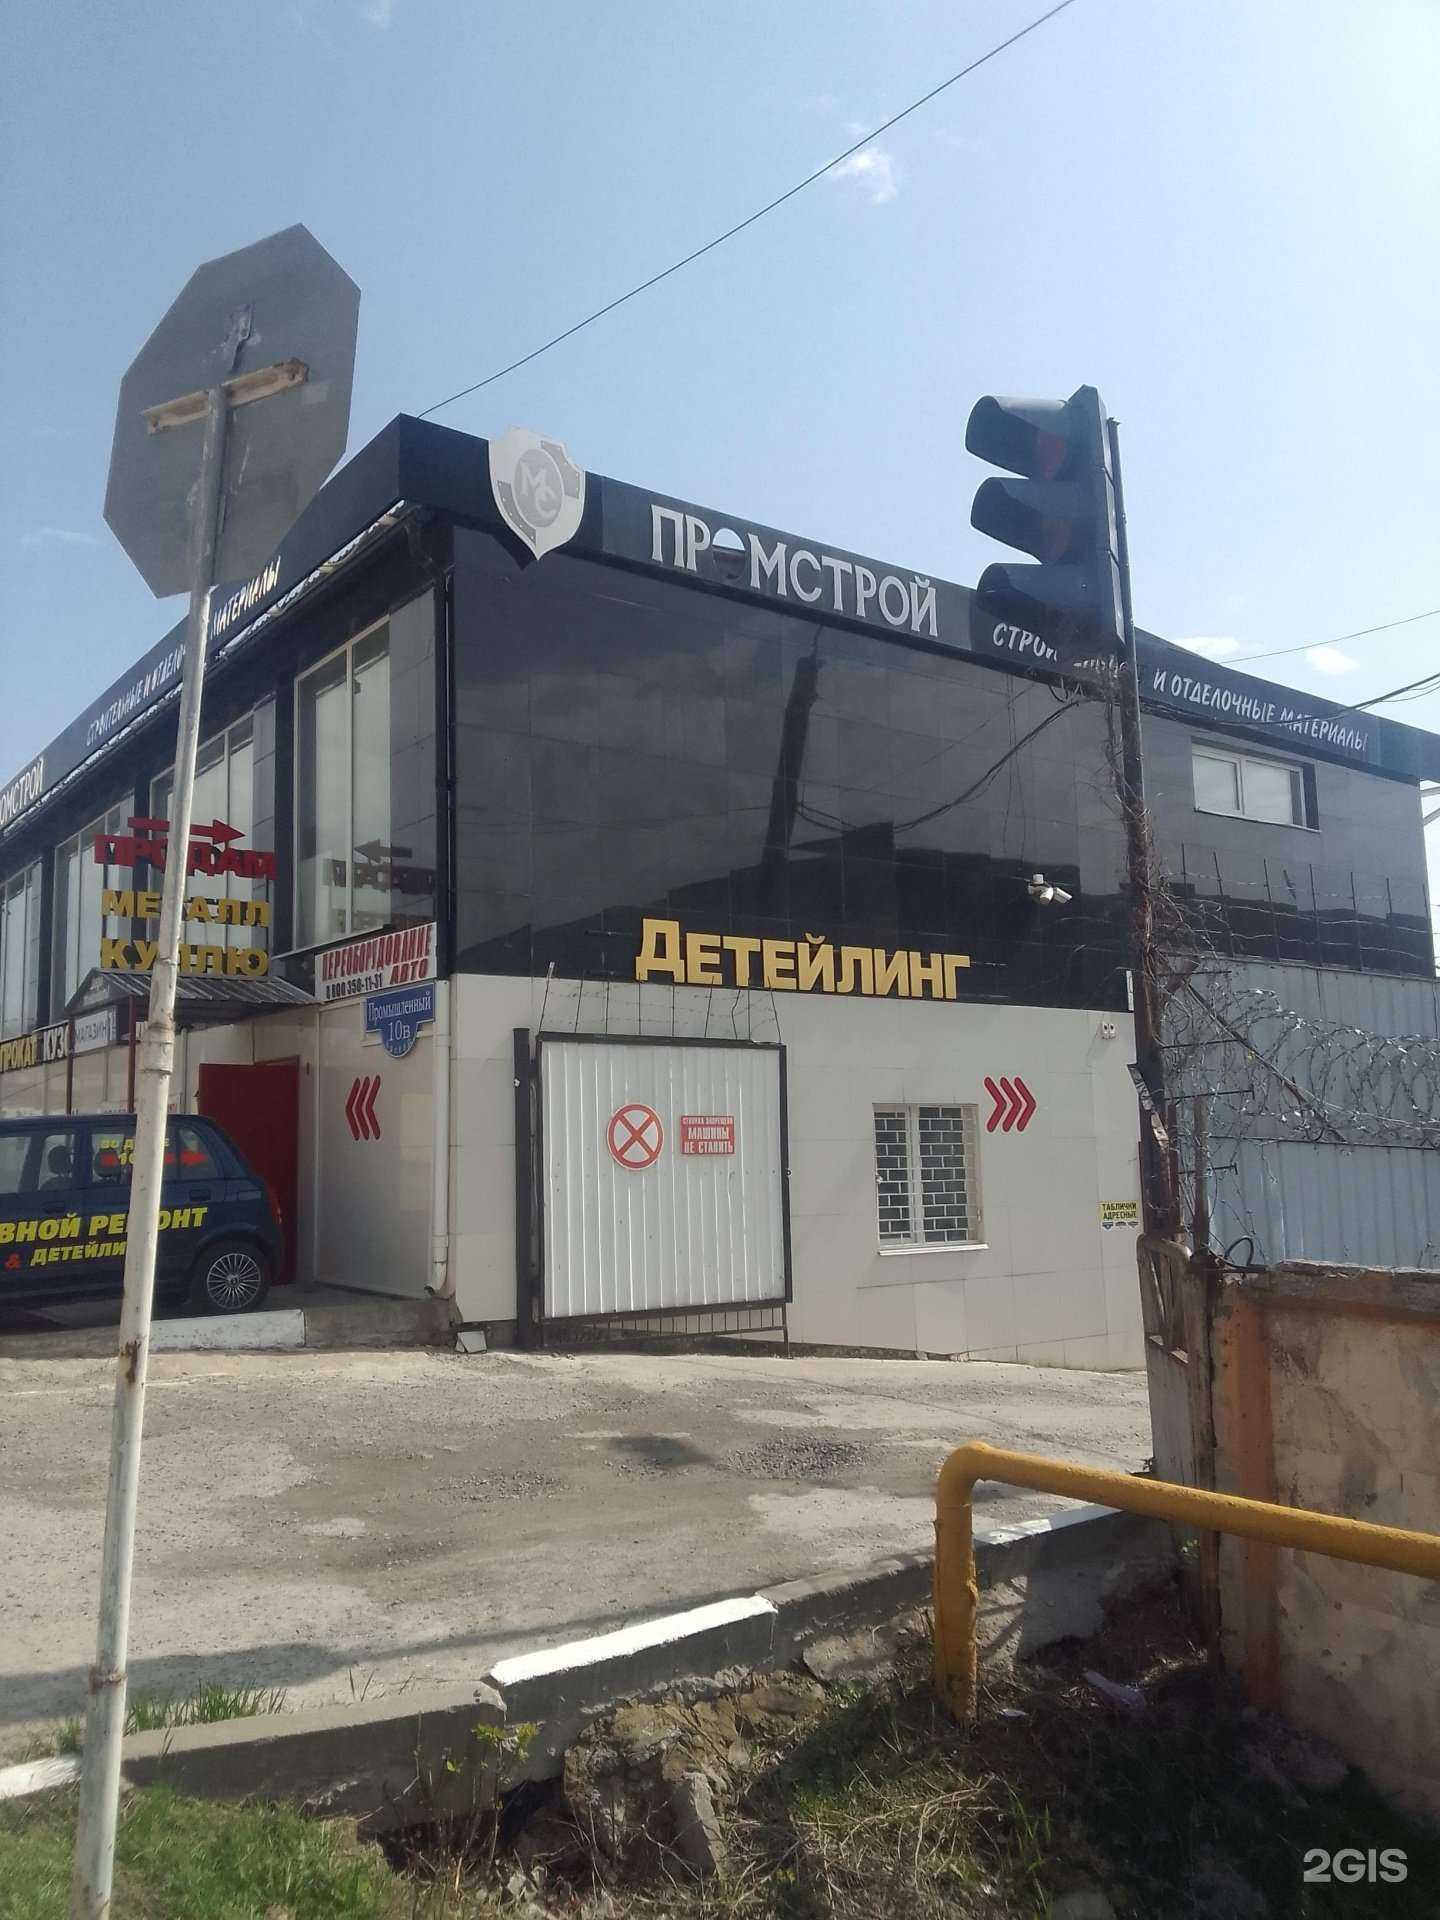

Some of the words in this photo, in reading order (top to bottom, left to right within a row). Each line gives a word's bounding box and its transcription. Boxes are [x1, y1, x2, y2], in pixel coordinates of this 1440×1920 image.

[1153, 667, 1167, 692] И
[1171, 673, 1276, 723] ОТДЕЛОЧНЫЕ
[1279, 706, 1369, 752] МАТЕРИАЛЫ
[101, 888, 270, 929] МЕАЛЛ
[322, 924, 432, 981] ПЕРЕОБОРУДОВАНИЕ
[635, 917, 970, 999] ДЕТЕЙЛИНГ
[389, 958, 429, 985] АВТО
[368, 991, 432, 1025] Промышленный
[684, 1141, 695, 1153] НЕ
[698, 1141, 734, 1153] СТАВИТЬ
[687, 1127, 730, 1140] МАШИНЫ
[88, 1206, 209, 1237] РЕОНТ
[1102, 1202, 1137, 1211] ТАБЛИЧКИ
[30, 1241, 128, 1267] ДЕТЕЙЛИ
